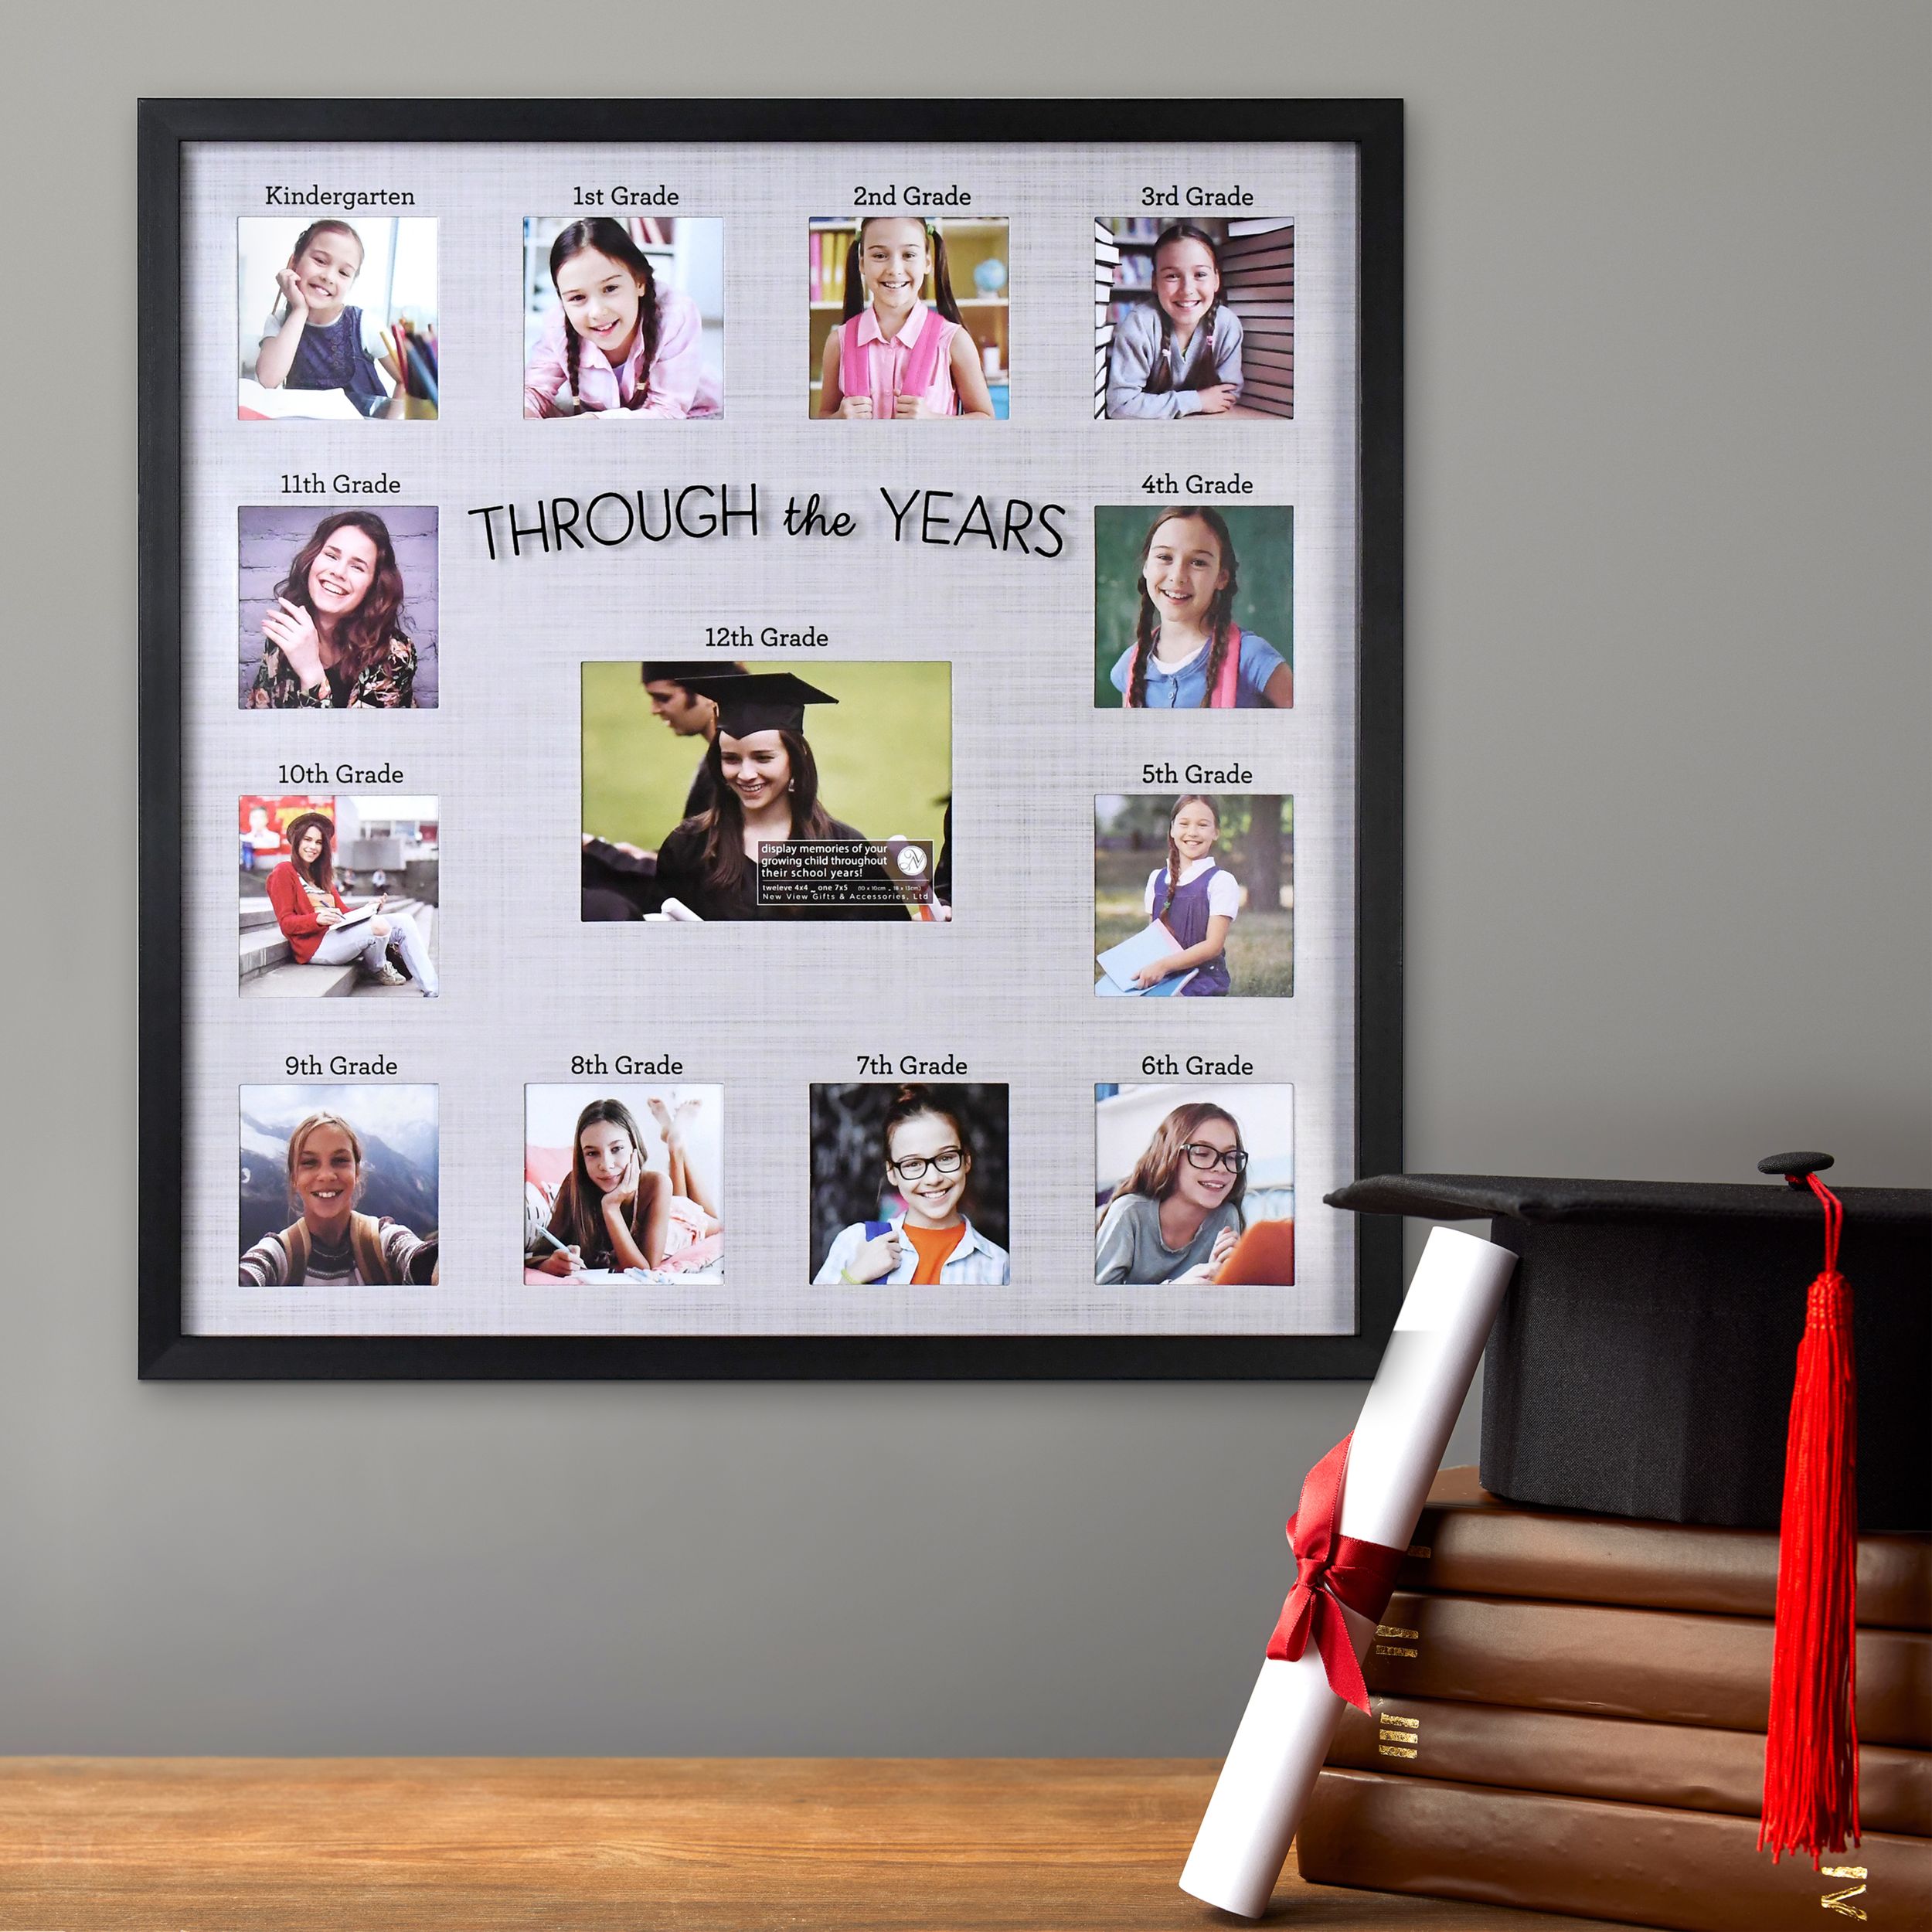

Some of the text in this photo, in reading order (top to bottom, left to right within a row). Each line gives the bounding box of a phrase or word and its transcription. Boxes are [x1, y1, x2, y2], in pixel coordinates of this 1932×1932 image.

[265, 184, 416, 210] Kindergarten
[573, 184, 679, 206] 1st Grade
[853, 184, 971, 206] 2nd Grade
[1141, 185, 1253, 206] 3rd Grade
[281, 472, 400, 494] 11th Grade
[1141, 472, 1253, 494] 4th Grade
[468, 483, 1066, 560] THROUGH the YEARS
[706, 625, 828, 647] 12th Grade
[279, 762, 403, 784] 10th Grade
[1142, 762, 1253, 784] 5th Grade
[761, 843, 888, 855] display memories of your
[761, 855, 888, 867] growing child throughout
[761, 867, 862, 879] their school years!
[285, 1054, 398, 1076] 9th Grade
[571, 1053, 683, 1075] 8th Grade
[857, 1053, 968, 1075] 7th Grade
[1141, 1054, 1253, 1076] 6th Grade
